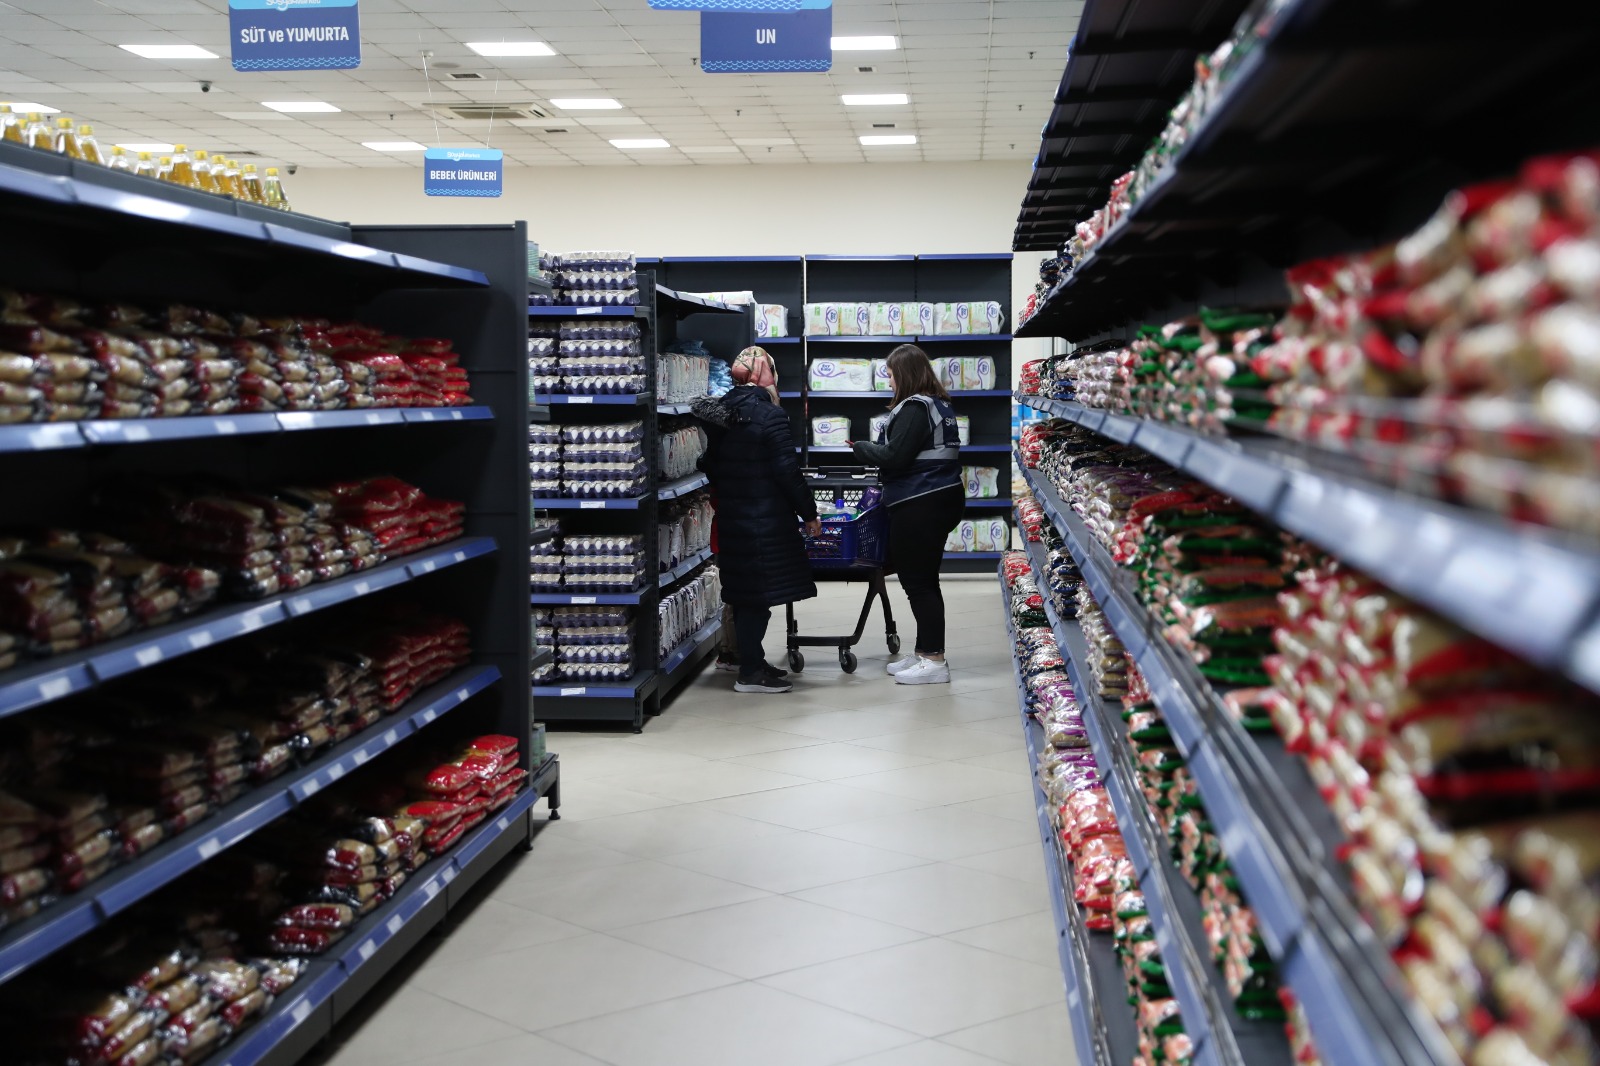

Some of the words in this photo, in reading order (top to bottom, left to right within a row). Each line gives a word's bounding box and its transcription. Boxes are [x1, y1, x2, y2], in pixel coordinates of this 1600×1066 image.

[240, 26, 266, 44] SÜT
[268, 30, 285, 43] ve
[286, 26, 350, 42] YUMURTA
[756, 28, 776, 45] UN
[430, 170, 457, 180] BEBEK
[457, 169, 497, 181] ÜRÜNLERİ
